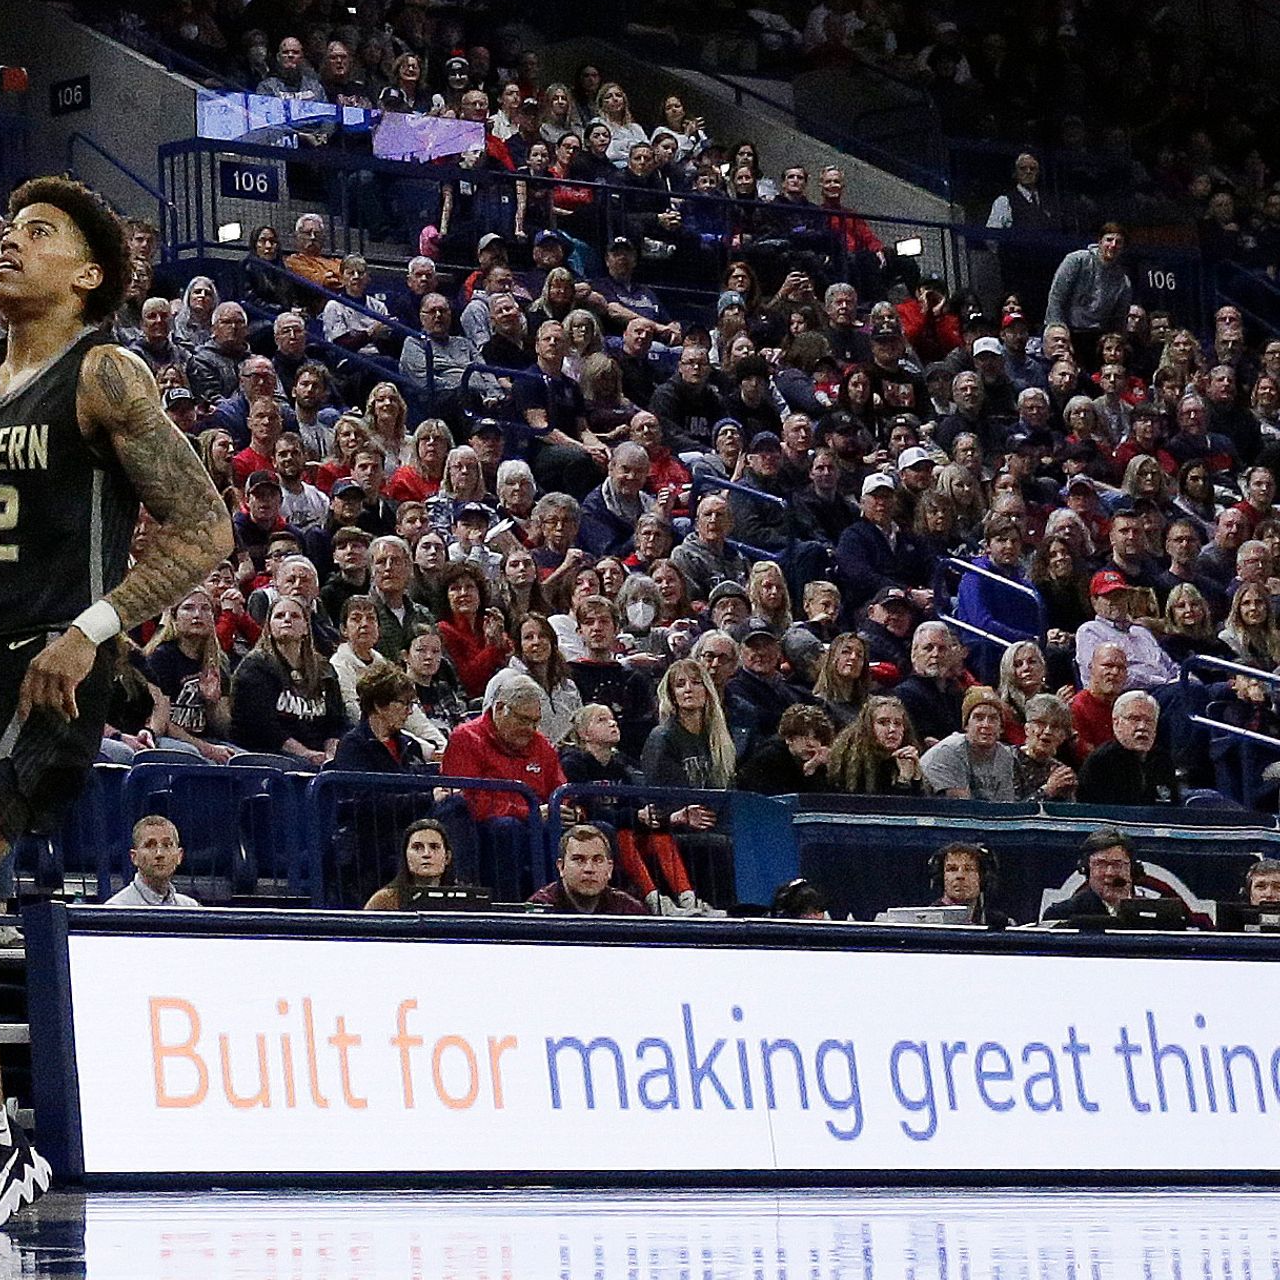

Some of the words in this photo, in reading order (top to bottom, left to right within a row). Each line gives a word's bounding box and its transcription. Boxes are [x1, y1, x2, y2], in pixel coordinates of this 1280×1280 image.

[58, 84, 83, 107] 106
[234, 170, 268, 193] 106
[1147, 270, 1176, 291] 106
[147, 995, 369, 1112] Built
[389, 998, 519, 1111] for
[544, 1004, 866, 1142] making
[888, 1025, 1100, 1142] great
[1113, 1009, 1280, 1113] thin
